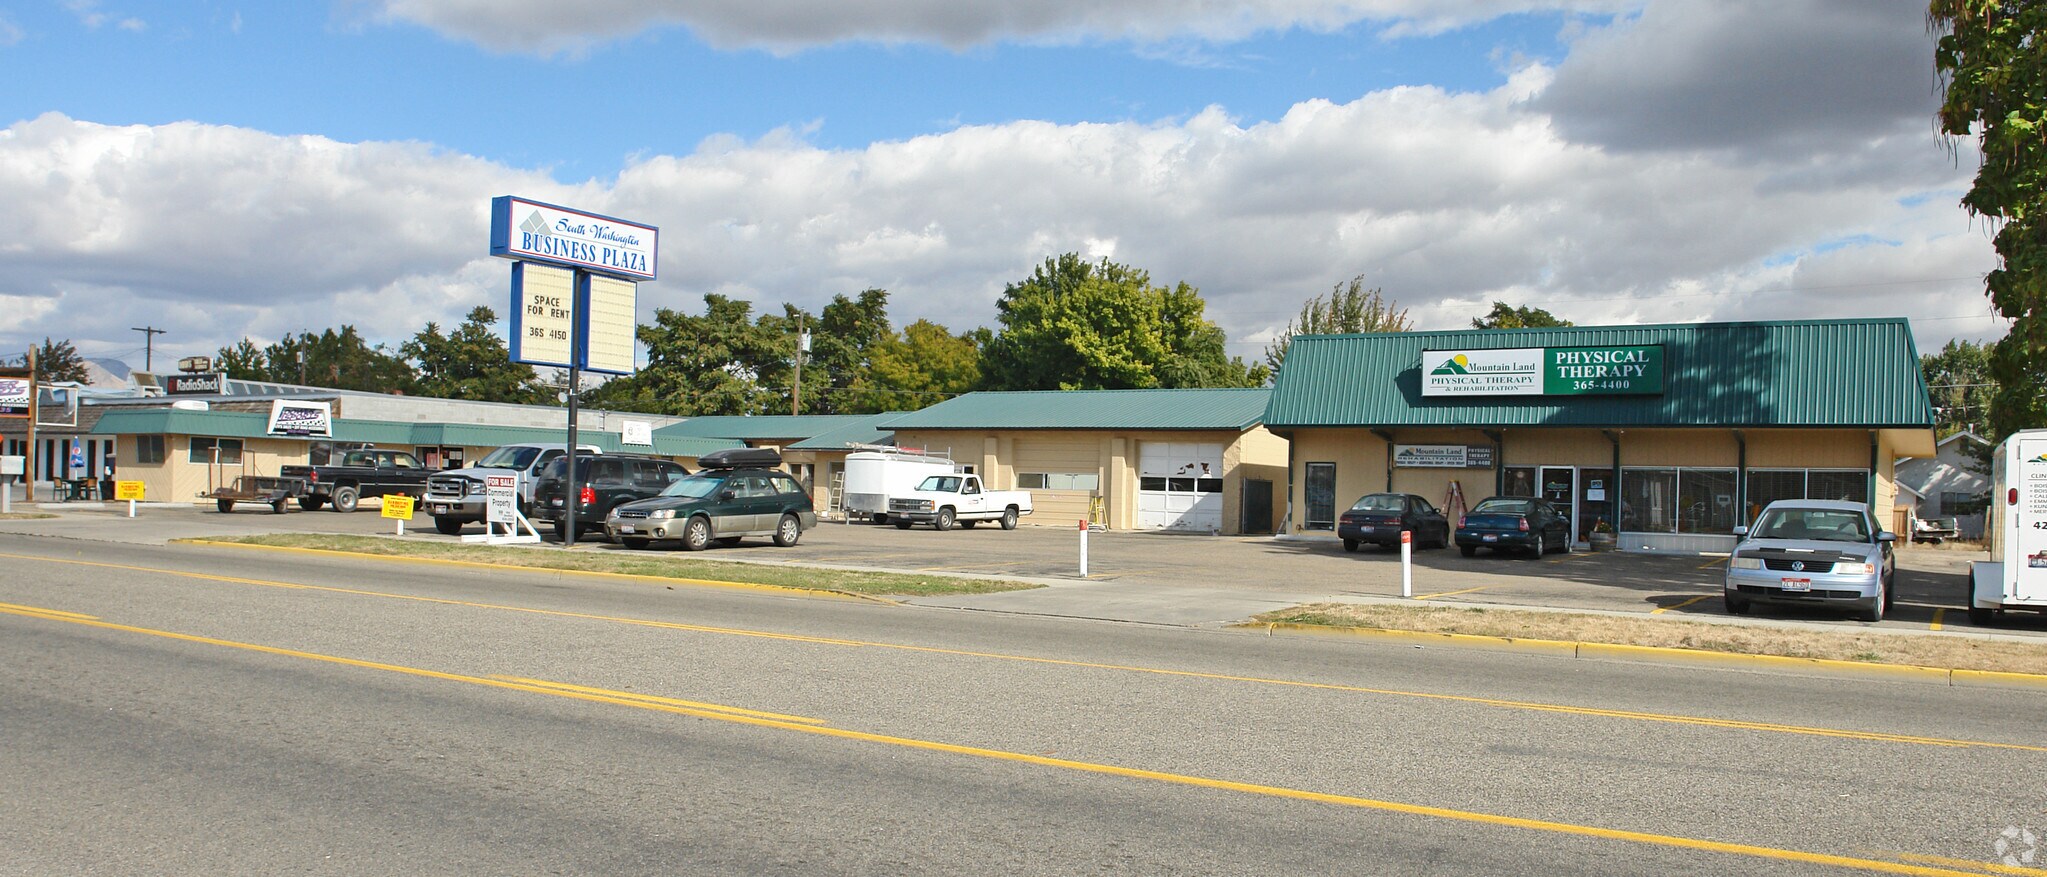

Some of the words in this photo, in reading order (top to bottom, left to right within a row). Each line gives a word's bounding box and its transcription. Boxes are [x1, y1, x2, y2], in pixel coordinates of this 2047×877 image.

[555, 218, 585, 236] South
[590, 224, 640, 249] Washington
[522, 231, 595, 262] BUSINESS
[602, 247, 647, 272] PLAZA
[534, 295, 560, 307] SPACE
[527, 304, 544, 316] FOR
[550, 308, 570, 320] RENT
[549, 329, 567, 341] 4150
[1555, 350, 1650, 365] PHYSICAL
[1468, 363, 1510, 372] Mountain
[1513, 361, 1536, 372] Land
[1557, 364, 1648, 379] THERAPY
[176, 377, 219, 392] RadioShack
[1430, 377, 1482, 385] PHYSICAL
[1485, 376, 1535, 384] THERAPY
[1573, 379, 1631, 391] 365-4400
[1453, 384, 1520, 392] REHABILITATION
[488, 478, 499, 486] FOR
[500, 479, 514, 487] SALE
